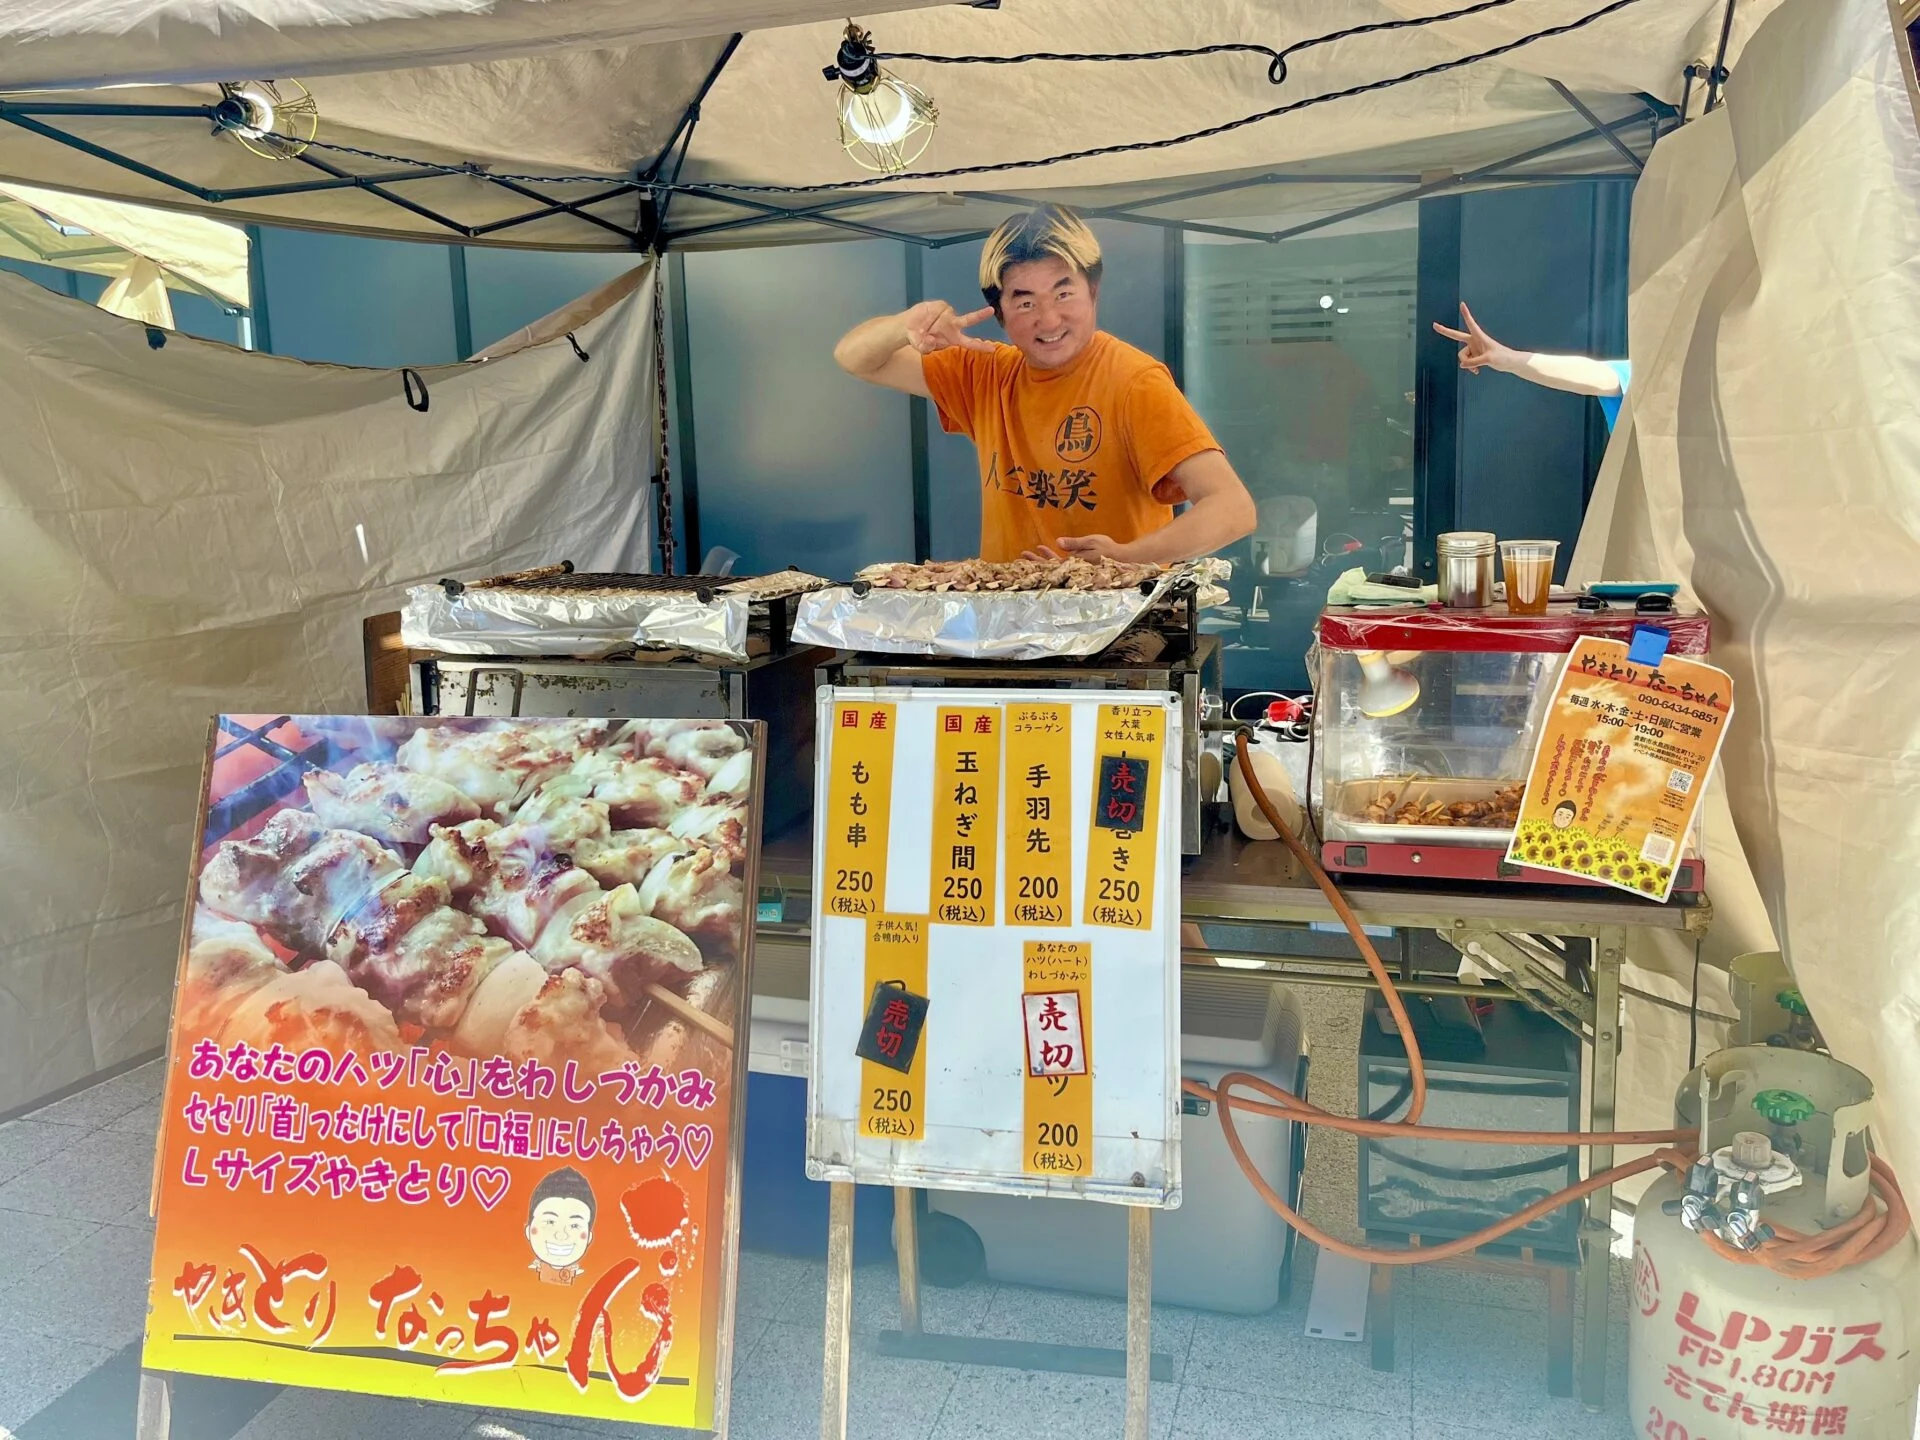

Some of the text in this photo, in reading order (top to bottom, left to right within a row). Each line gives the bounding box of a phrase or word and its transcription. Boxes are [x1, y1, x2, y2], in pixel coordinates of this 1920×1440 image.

[1057, 412, 1094, 452] 鳥
[1582, 654, 1719, 707] やきとり なっちゃん
[1111, 705, 1152, 717] 香り立つ
[1570, 694, 1589, 707] 毎週
[1638, 693, 1719, 725] 090-6434-6851
[841, 709, 886, 731] 国産
[943, 713, 992, 735] 国産
[1014, 723, 1064, 733] コラーゲン
[1120, 718, 1141, 730] 大葉
[1104, 729, 1155, 743] 女性人気串
[846, 761, 870, 849] もも串
[1107, 763, 1137, 823] 売切
[951, 751, 979, 871] 玉ねぎ間
[1025, 763, 1051, 853] 手羽先
[836, 869, 873, 893] 250
[943, 876, 983, 900] 250
[1018, 876, 1059, 899] 200
[1098, 877, 1140, 903] 250
[830, 895, 876, 915] (税込)
[938, 903, 986, 923] (税込)
[1014, 904, 1063, 922] (税込)
[1092, 905, 1142, 927] (税込)
[873, 932, 919, 944] 合鴨肉入り
[876, 920, 918, 932] 子供人気!
[1036, 942, 1078, 953] あなたの
[1026, 955, 1088, 967] ハツ(ハート)
[877, 999, 909, 1057] 売切
[1039, 995, 1074, 1069] 売切
[188, 1037, 716, 1110] あなたのハツ「心」をわしづかみ
[873, 1087, 912, 1113] 250
[183, 1092, 686, 1168] セセリ「首」ったけにして「口福」にしちゃう
[868, 1116, 915, 1137] (税込)
[1038, 1122, 1079, 1148] 200
[1033, 1151, 1083, 1172] (税込)
[182, 1147, 466, 1204] Lサイズやきとり
[172, 1243, 672, 1402] やきとり なっちゃん
[1675, 1291, 1886, 1365] LPガス
[1678, 1335, 1836, 1394] FP1.80M
